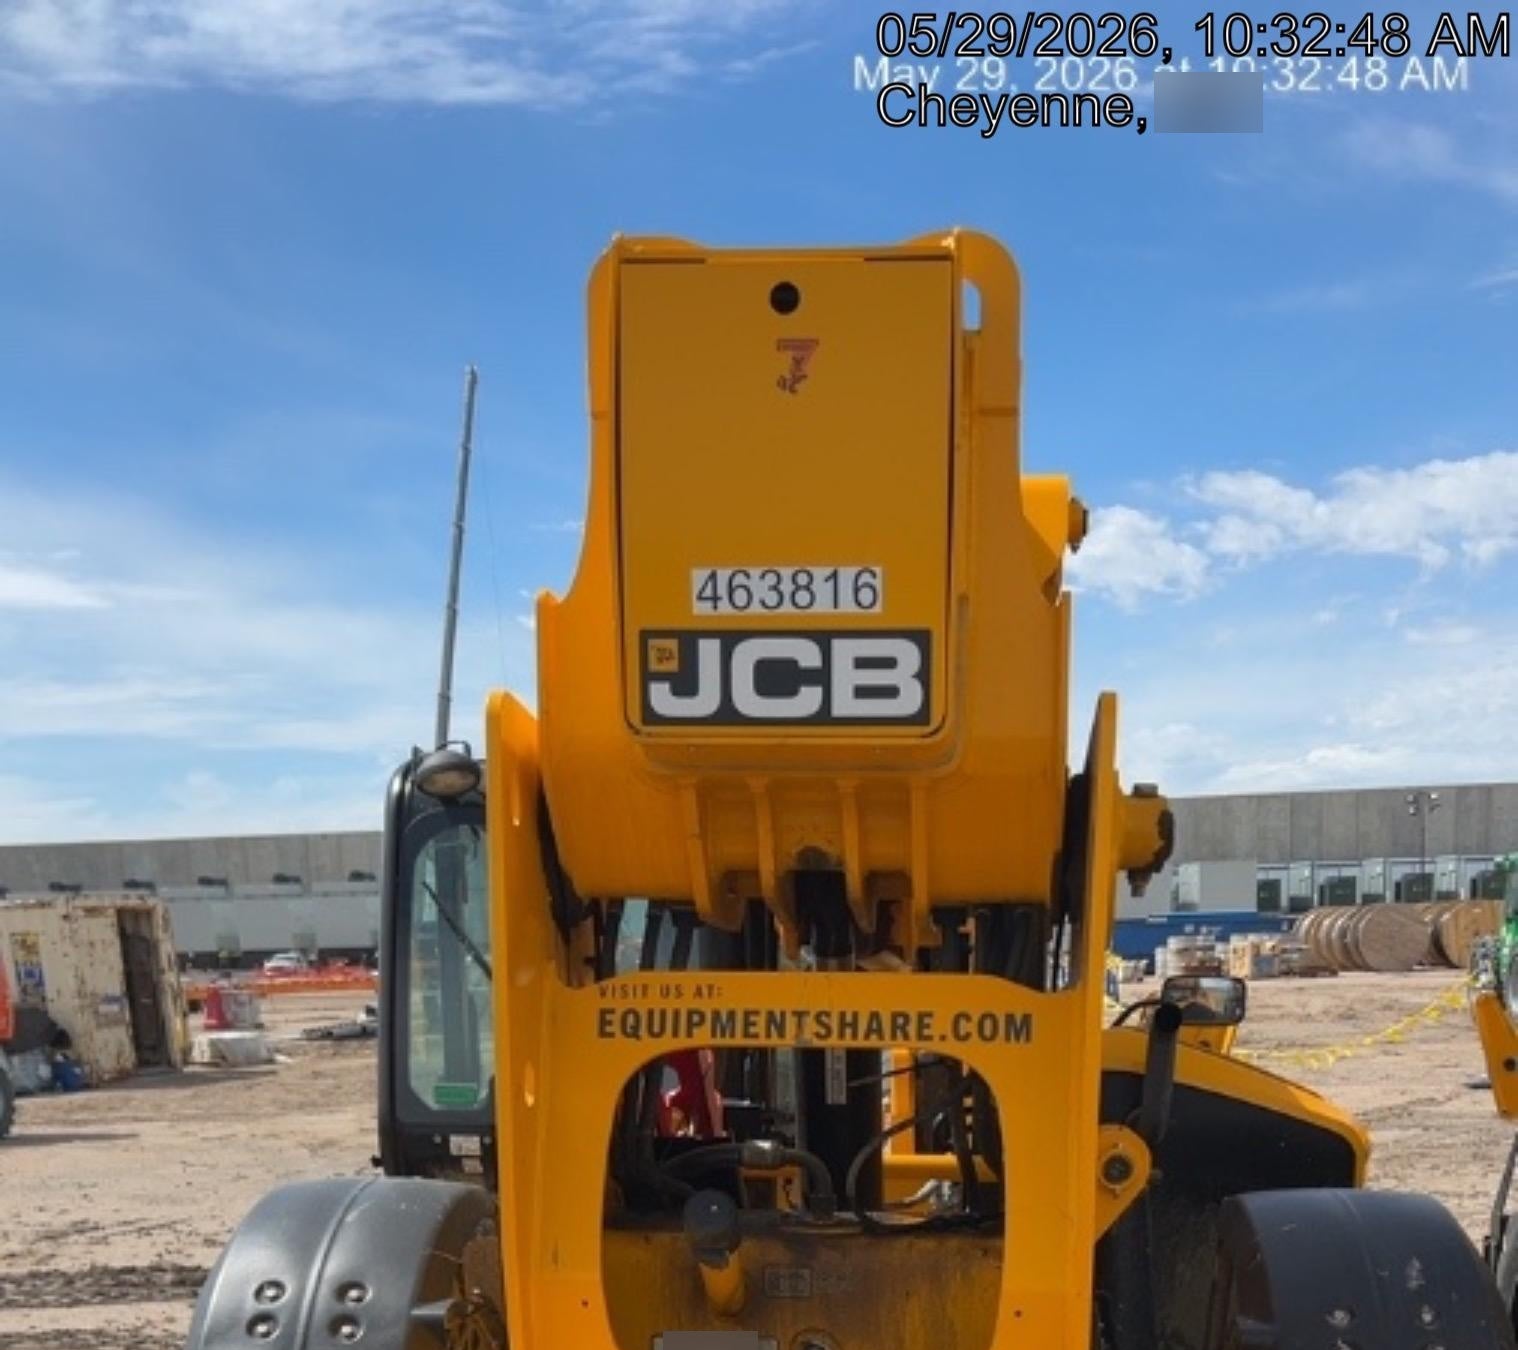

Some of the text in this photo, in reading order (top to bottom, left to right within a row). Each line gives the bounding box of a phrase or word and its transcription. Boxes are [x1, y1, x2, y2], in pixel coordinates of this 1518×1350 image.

[695, 567, 878, 611] 463816
[648, 637, 924, 718] JCB
[599, 983, 648, 1000] VISIT
[659, 984, 685, 1000] US
[597, 1007, 1033, 1043] EQUIPMENTSHARE.COM
